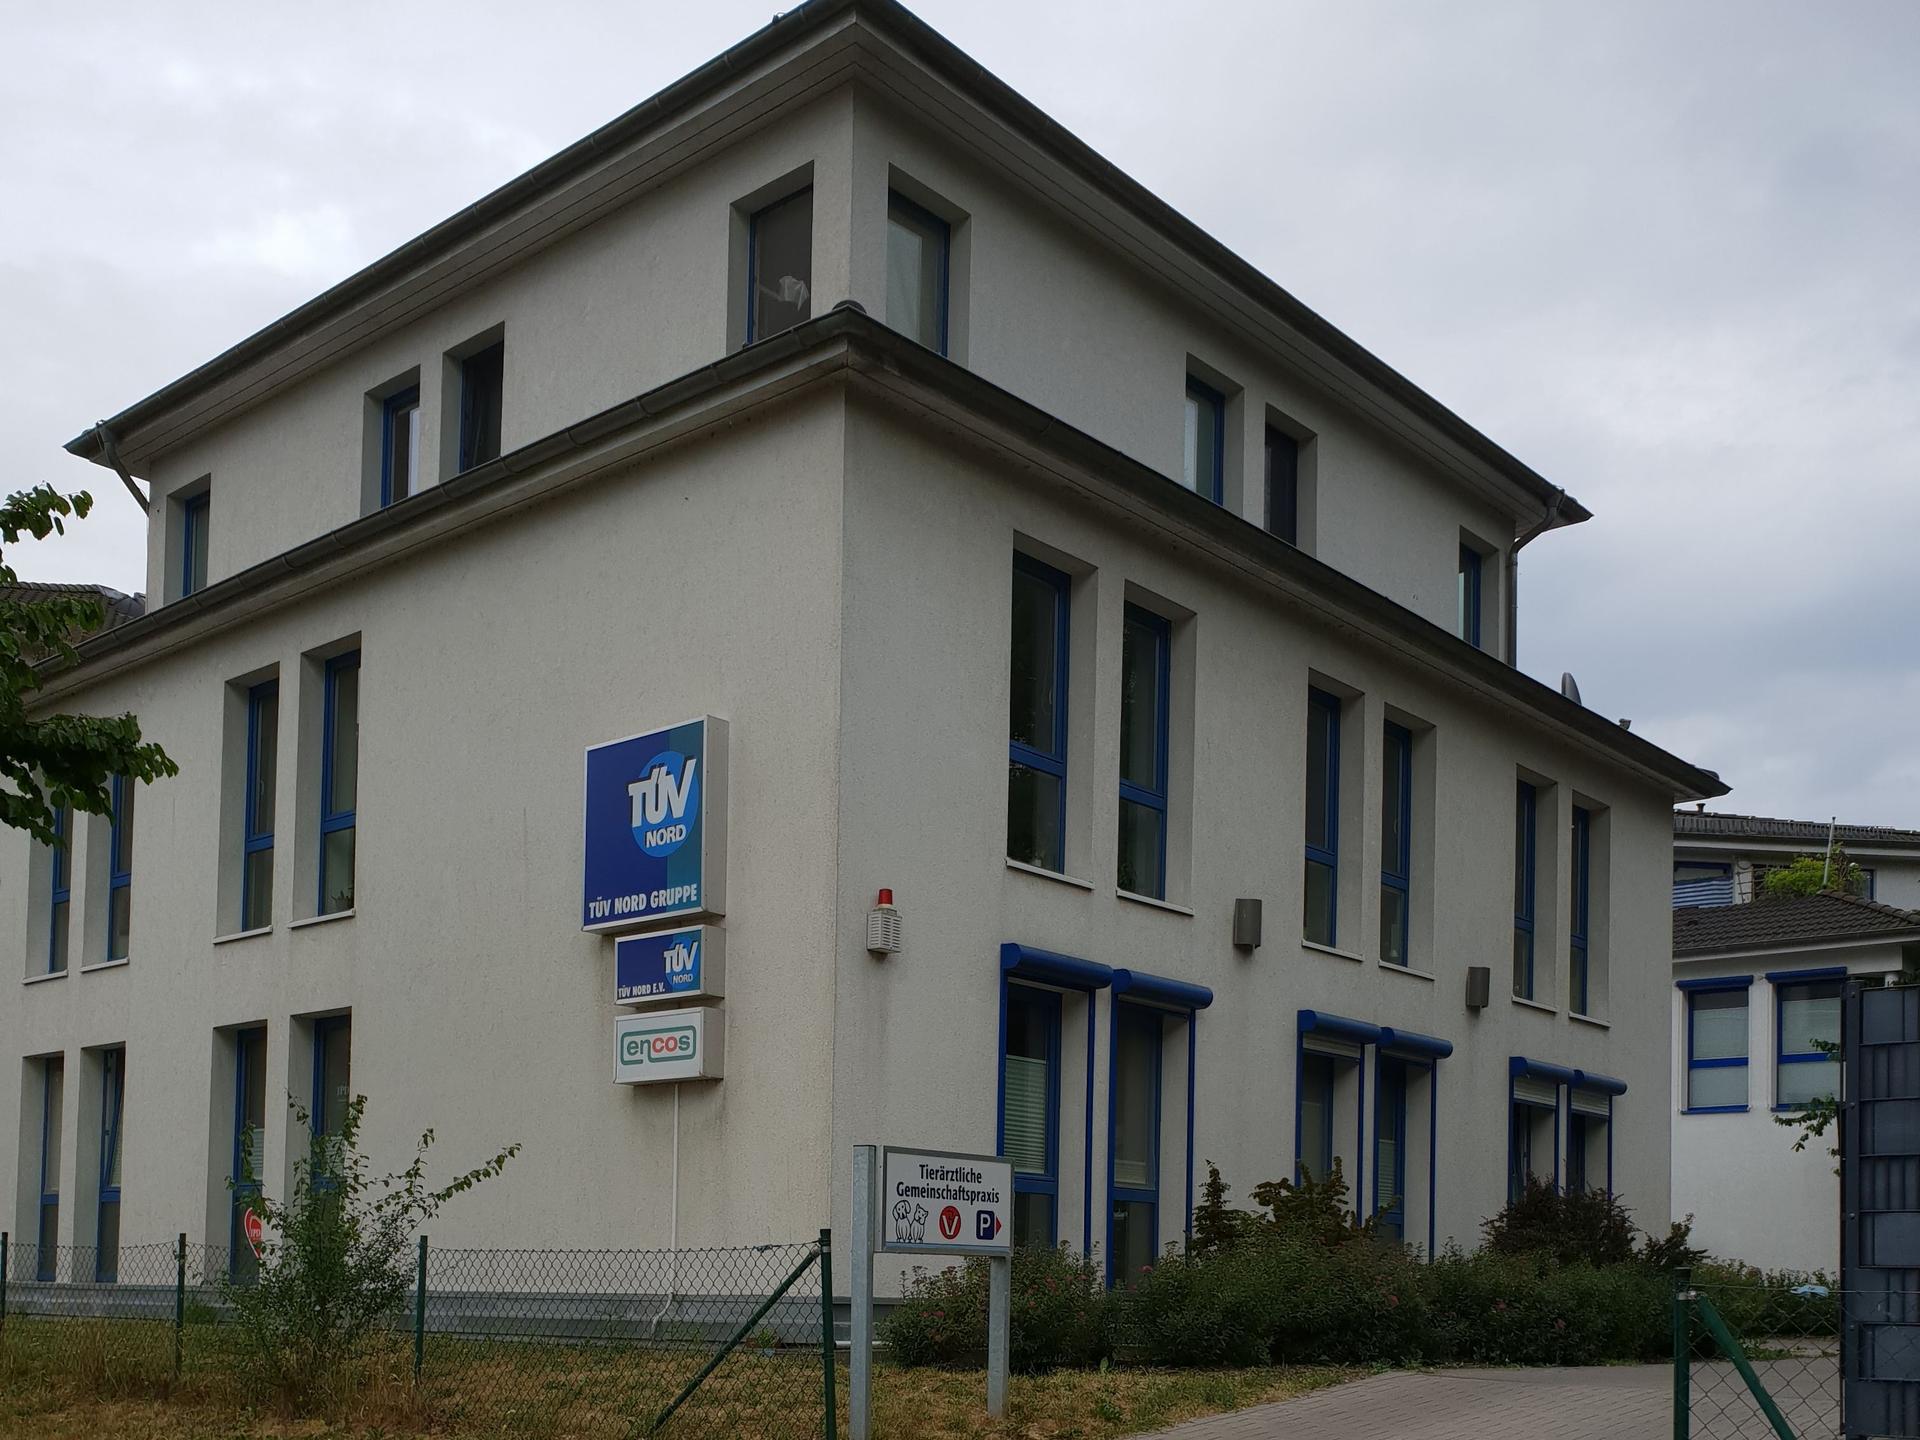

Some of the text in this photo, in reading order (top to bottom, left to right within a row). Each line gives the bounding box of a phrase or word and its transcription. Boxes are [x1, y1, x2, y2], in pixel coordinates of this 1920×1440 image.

[628, 757, 697, 828] TÜV
[645, 824, 687, 848] NORD
[589, 883, 697, 919] TÜV NORD GRUPPE
[664, 941, 698, 974] TÜV
[618, 982, 666, 998] TÜV NORD E.V.
[673, 973, 694, 985] NORD
[626, 1035, 690, 1056] encos
[919, 1164, 982, 1184] Tierärztliche
[896, 1181, 1000, 1205] Gemeinschaftspraxis
[980, 1213, 991, 1237] P
